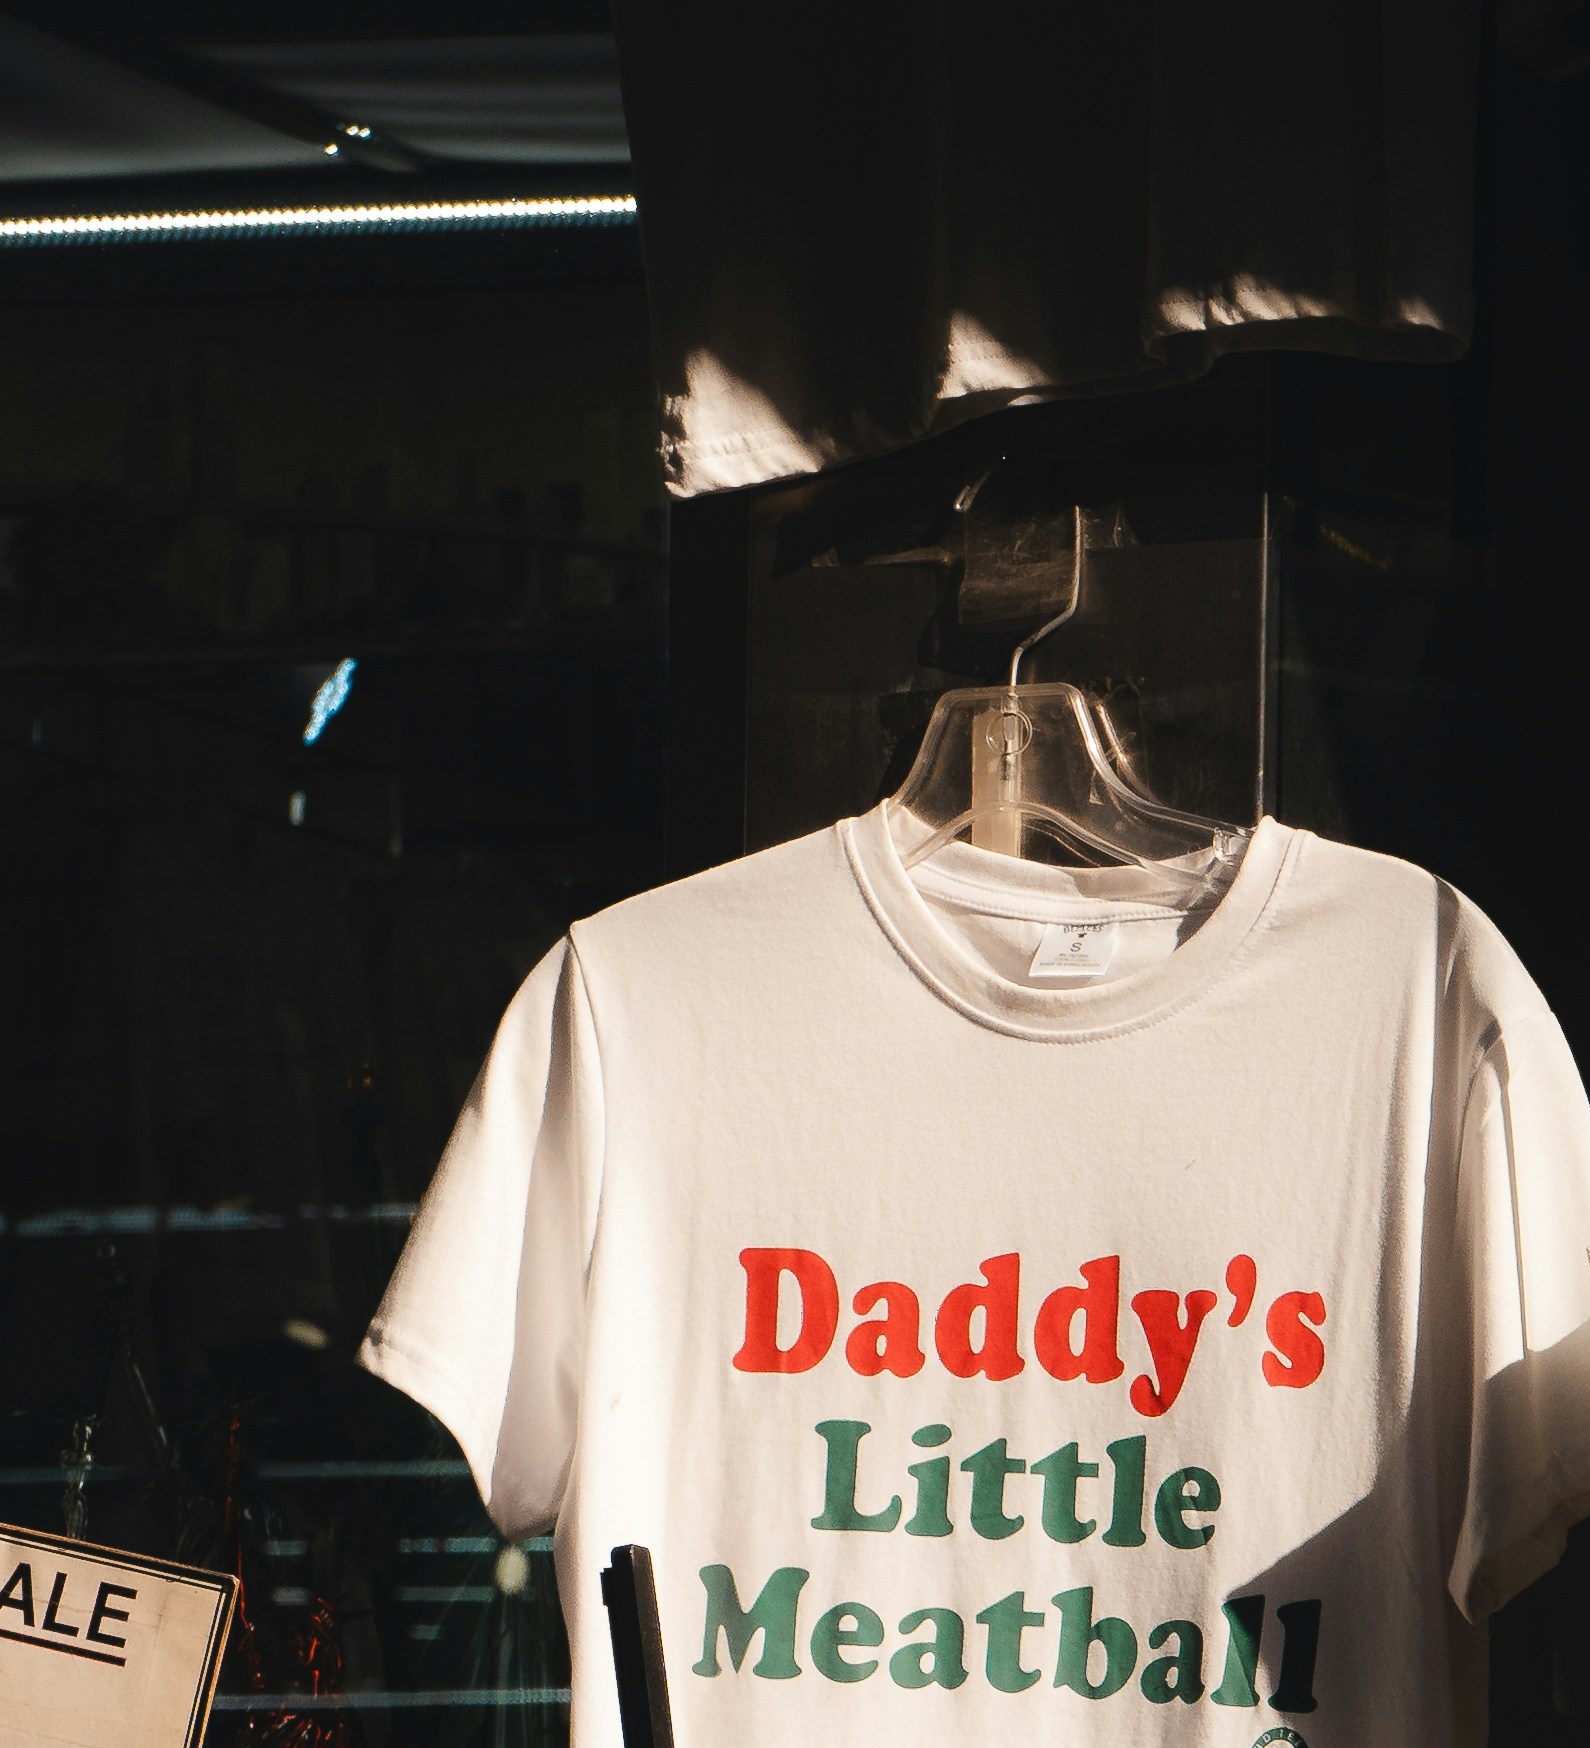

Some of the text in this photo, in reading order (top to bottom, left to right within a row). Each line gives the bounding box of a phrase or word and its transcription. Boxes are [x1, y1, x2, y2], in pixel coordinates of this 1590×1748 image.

[1070, 942, 1083, 952] S
[732, 1247, 1328, 1418] Daddy's
[810, 1419, 1222, 1549] Little
[691, 1563, 1323, 1714] Meatball
